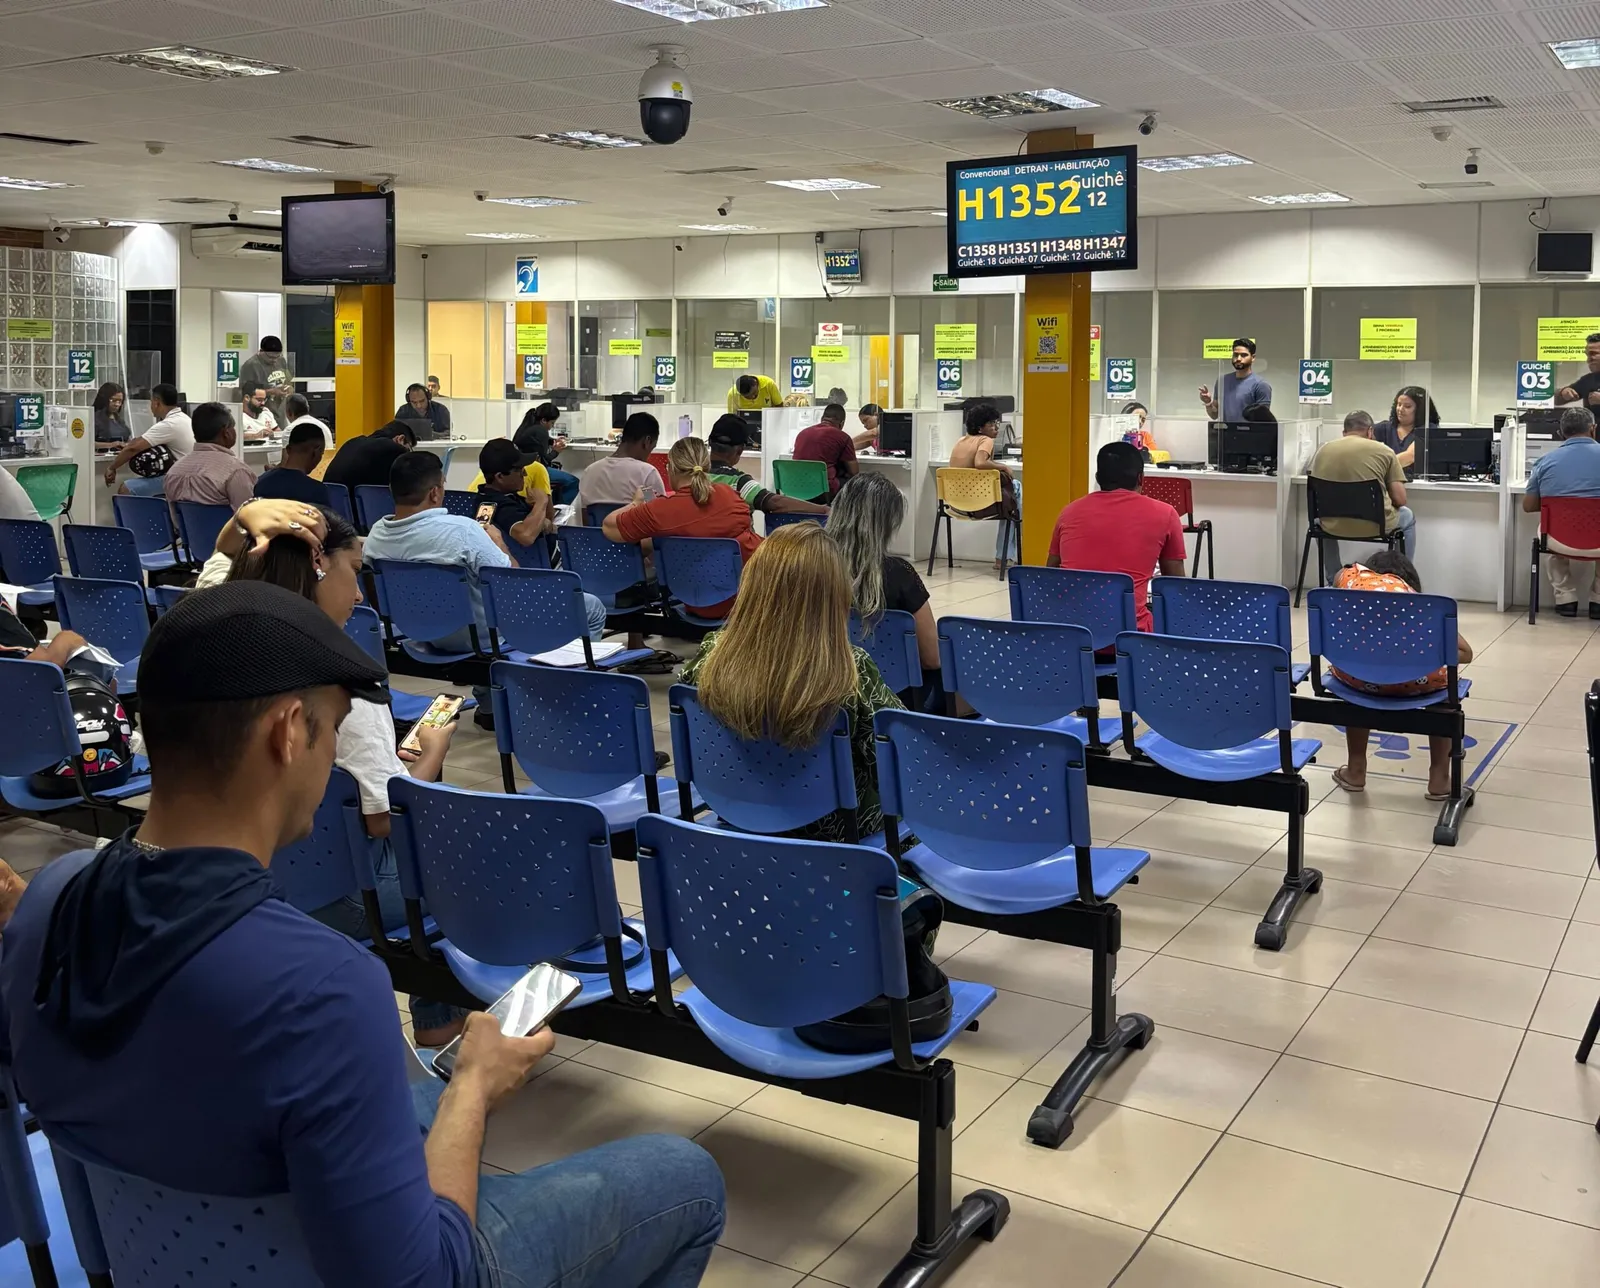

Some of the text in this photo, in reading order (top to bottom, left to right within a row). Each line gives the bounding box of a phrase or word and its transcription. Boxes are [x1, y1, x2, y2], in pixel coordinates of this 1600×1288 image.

[960, 168, 1010, 179] Convencional
[1015, 164, 1048, 174] DETRAN
[1054, 158, 1110, 171] HABILITAÇÃO
[1070, 171, 1124, 189] Guichê
[958, 179, 1081, 221] H1352
[1087, 191, 1107, 207] 12
[958, 236, 1126, 257] C1358 H1351 H1348 H1347
[825, 255, 850, 267] H1352
[958, 258, 985, 267] Guichê:
[998, 255, 1027, 265] Guichê:
[1028, 255, 1038, 263] 07
[1040, 253, 1069, 262] Guichê:
[1071, 252, 1081, 260] 12
[1083, 250, 1113, 260] Guichê:
[1116, 250, 1126, 258] 12
[341, 322, 355, 330] Wifi
[1036, 317, 1058, 326] Wifi
[73, 359, 90, 373] 12
[222, 360, 233, 373] 11
[526, 362, 542, 374] 09
[657, 364, 674, 377] 08
[793, 365, 811, 378] 07
[1521, 362, 1551, 370] GUICHÊ
[939, 367, 960, 381] 06
[1110, 368, 1133, 383] 05
[1302, 369, 1330, 385] 04
[1521, 372, 1551, 389] 03
[21, 405, 39, 420] 13
